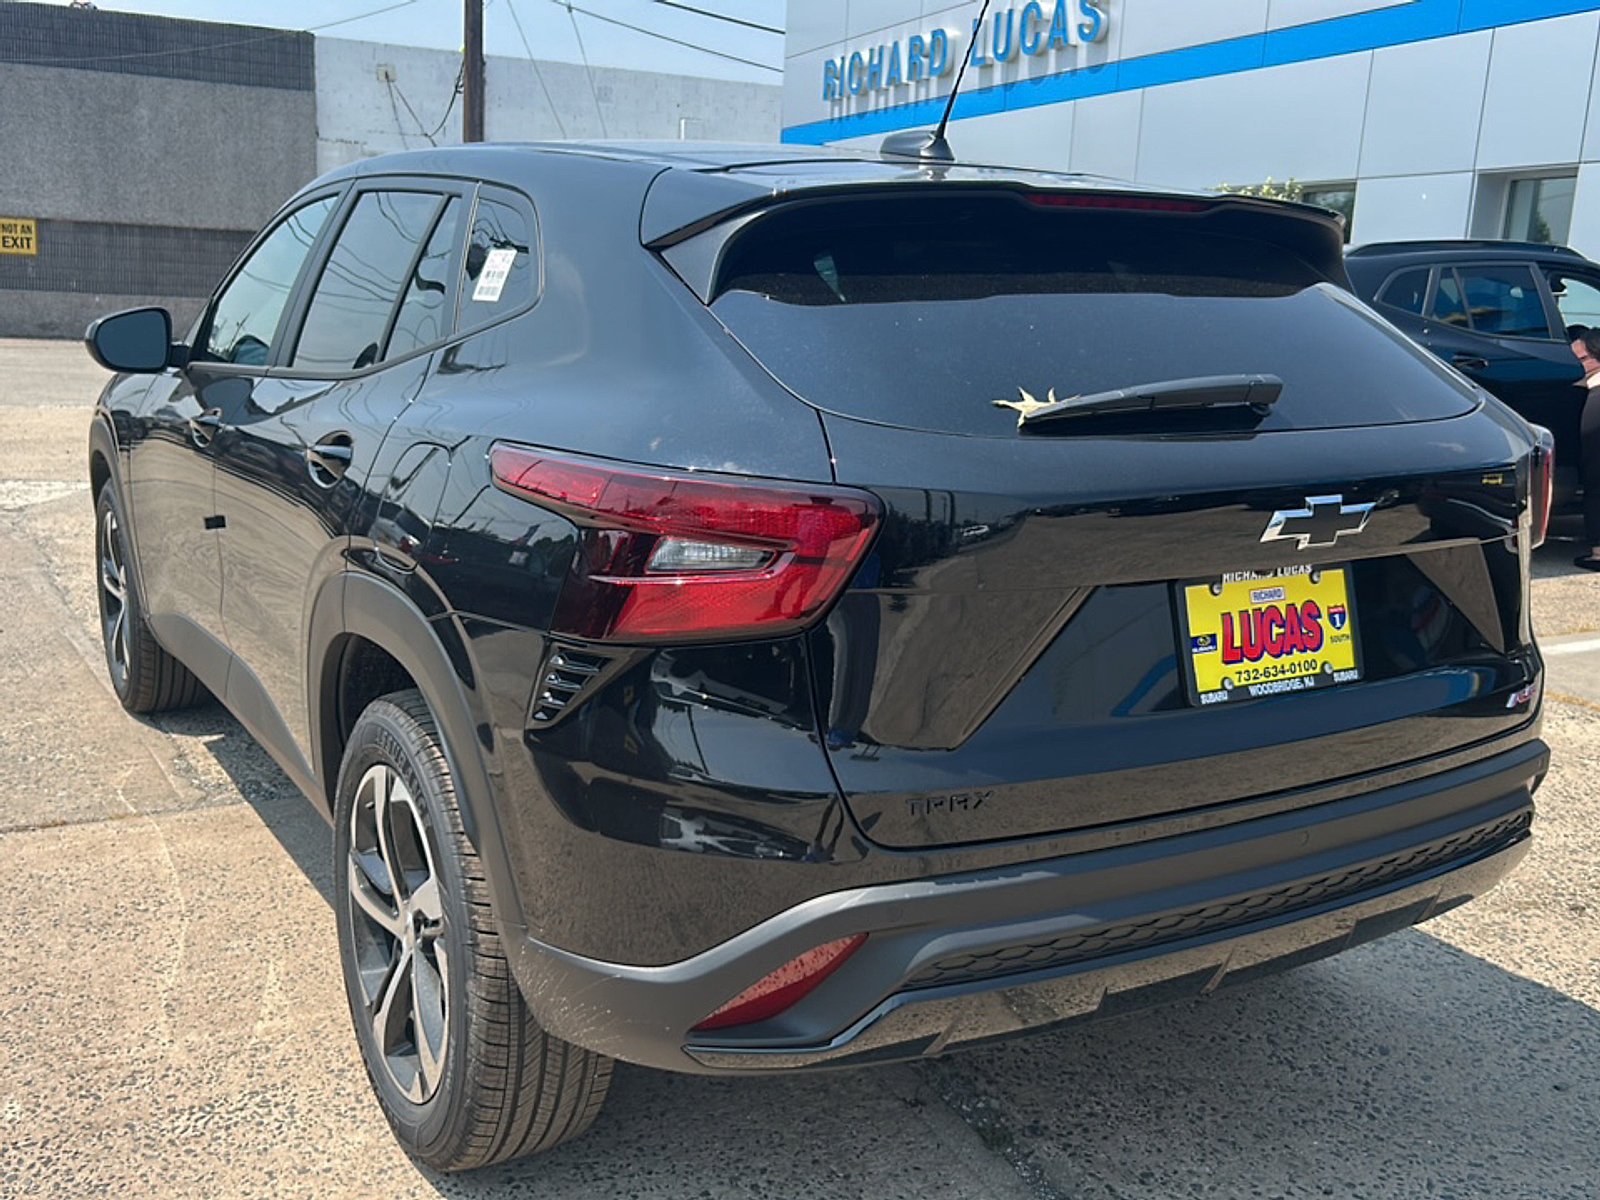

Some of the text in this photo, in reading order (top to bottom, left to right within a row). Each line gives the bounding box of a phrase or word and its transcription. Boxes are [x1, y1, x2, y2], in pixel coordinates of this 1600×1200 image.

[823, 0, 1106, 101] RICHARD LUCAS
[20, 224, 33, 235] AN
[2, 236, 33, 250] EXIT
[1222, 563, 1313, 583] RICHA LUCAS
[1253, 589, 1283, 601] RICHARD
[1333, 613, 1342, 628] 1
[1221, 600, 1323, 664] LUCAS
[1235, 659, 1318, 683] 732-634-0100
[905, 790, 994, 816] TRAX
